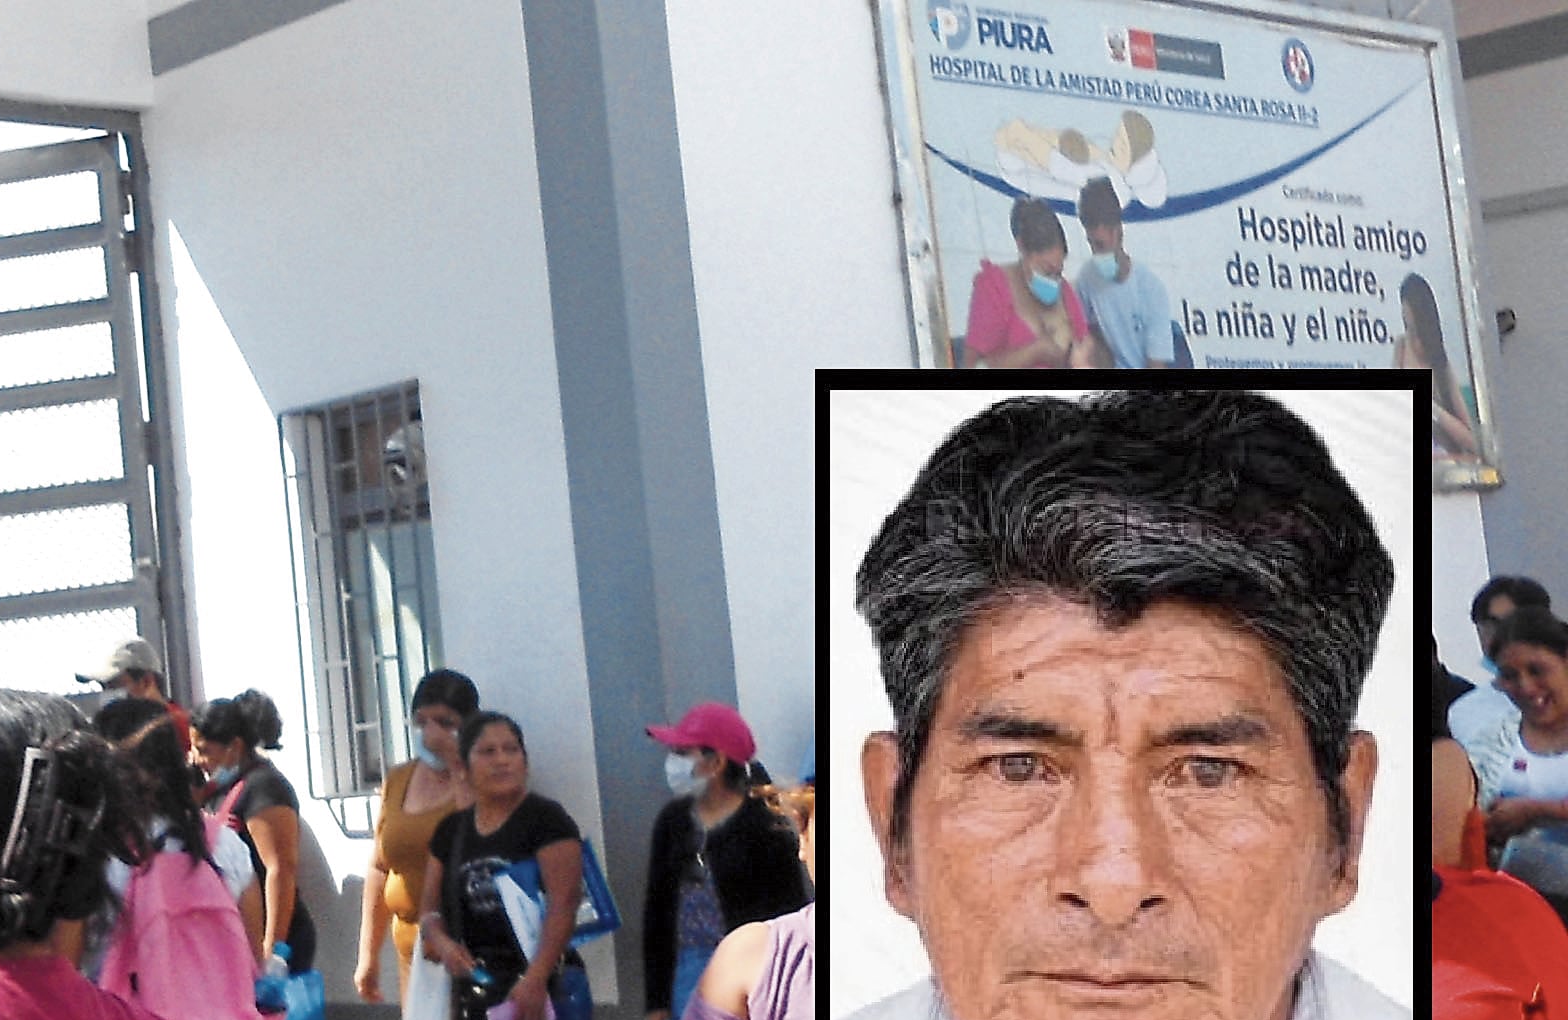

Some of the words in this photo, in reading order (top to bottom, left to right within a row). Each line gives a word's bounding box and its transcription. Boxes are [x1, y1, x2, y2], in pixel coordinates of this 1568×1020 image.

[977, 17, 1053, 54] PIURA
[930, 55, 1006, 83] HOSPITAL
[1011, 65, 1032, 86] DE
[1035, 68, 1055, 88] LA
[1059, 72, 1122, 98] AMISTAD
[1126, 78, 1162, 105] PERÚ
[1166, 87, 1212, 111] COREA
[1215, 94, 1259, 116] SANTA
[1262, 100, 1296, 120] ROSA
[1237, 207, 1345, 252] Hospital
[1354, 220, 1427, 260] amigo
[1226, 251, 1259, 287] de
[1268, 254, 1292, 289] la
[1300, 260, 1385, 301] madre,
[1182, 299, 1208, 336] la
[1216, 301, 1275, 339] niña
[1282, 312, 1296, 346] y
[1306, 306, 1328, 341] el
[1335, 308, 1394, 344] niño.
